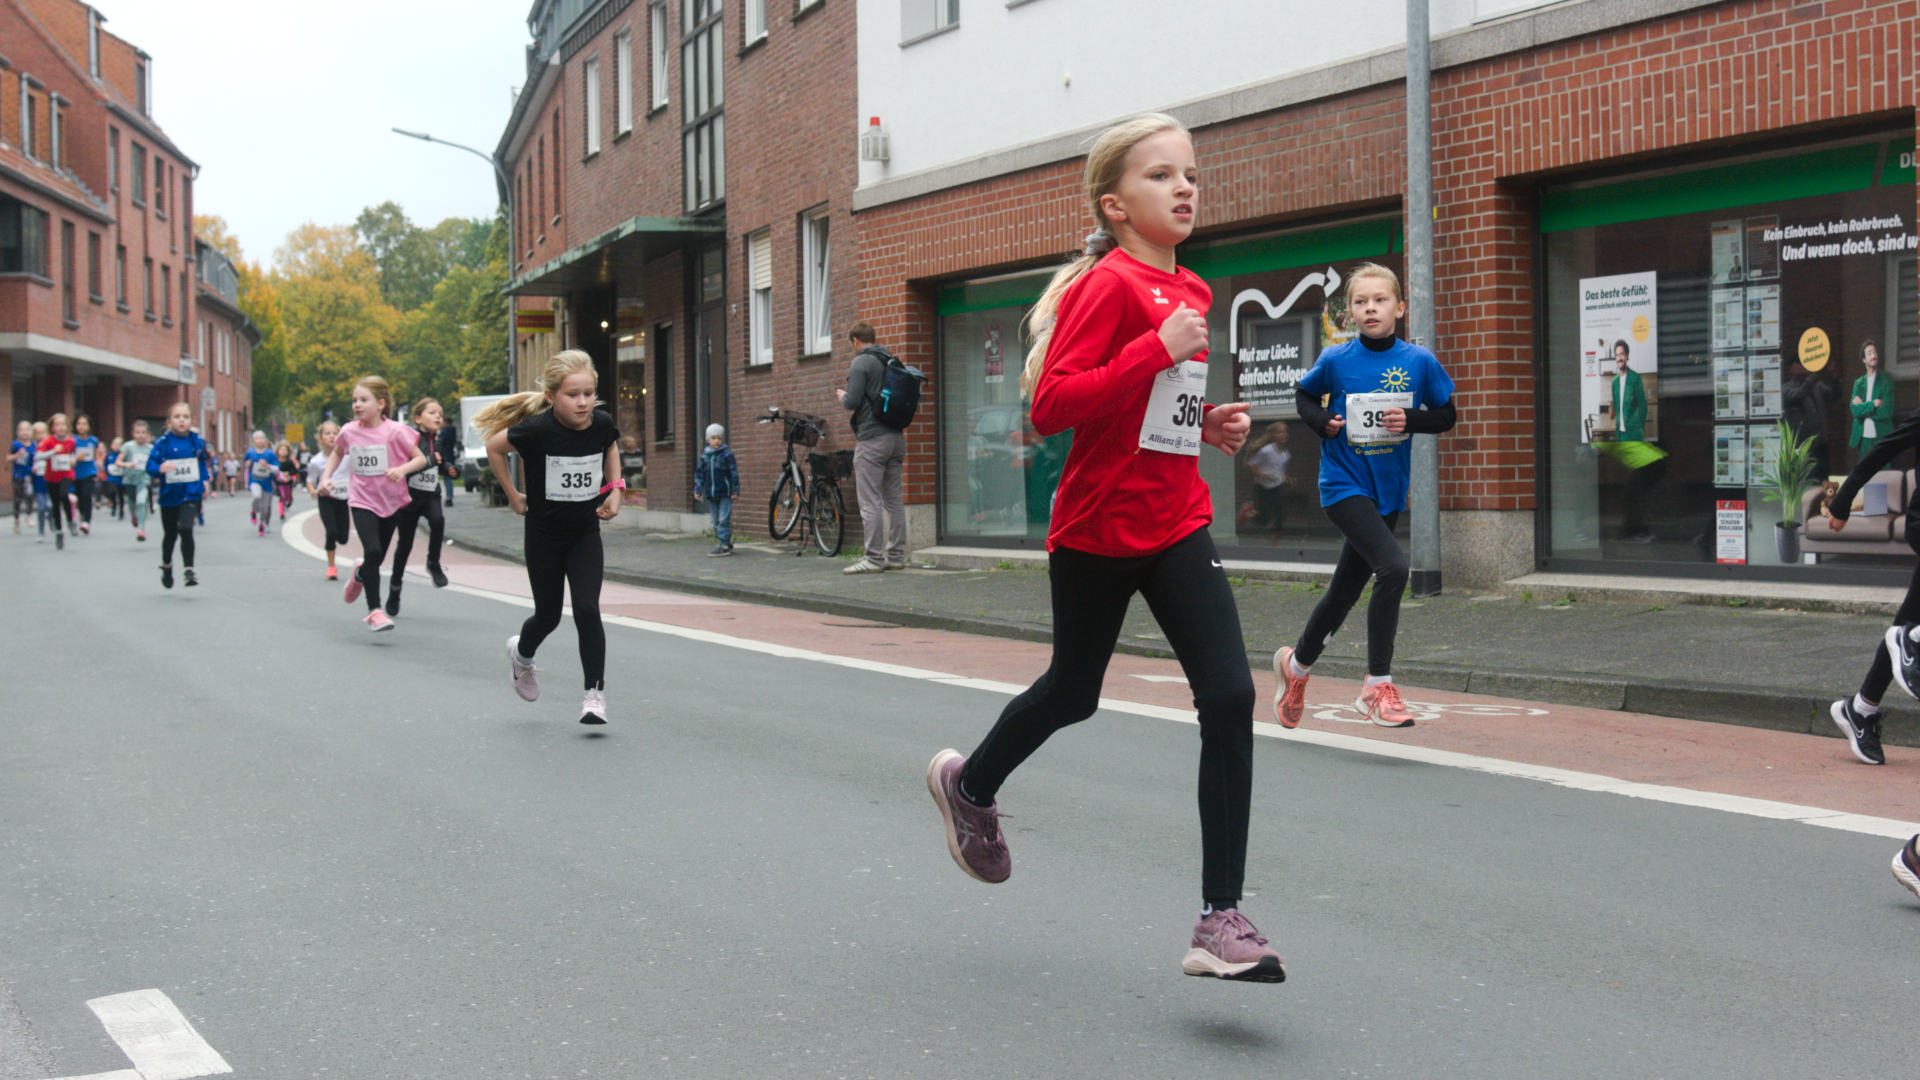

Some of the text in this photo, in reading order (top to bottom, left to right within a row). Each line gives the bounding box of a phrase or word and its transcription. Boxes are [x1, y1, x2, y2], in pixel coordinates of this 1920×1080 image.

[1764, 213, 1904, 242] Kein Einbruch, kein Rohrbruch.
[1782, 242, 1807, 261] Und
[1807, 243, 1841, 258] wenn
[1842, 236, 1876, 255] doch,
[1877, 232, 1907, 252] sind
[1585, 284, 1649, 301] Das beste Gefühl:
[1616, 299, 1630, 308] nichts
[1238, 343, 1298, 363] Mut zur Lücke:
[1239, 366, 1275, 386] einfach
[1149, 433, 1175, 446] Allianz
[357, 455, 378, 467] 320
[561, 472, 592, 488] 335
